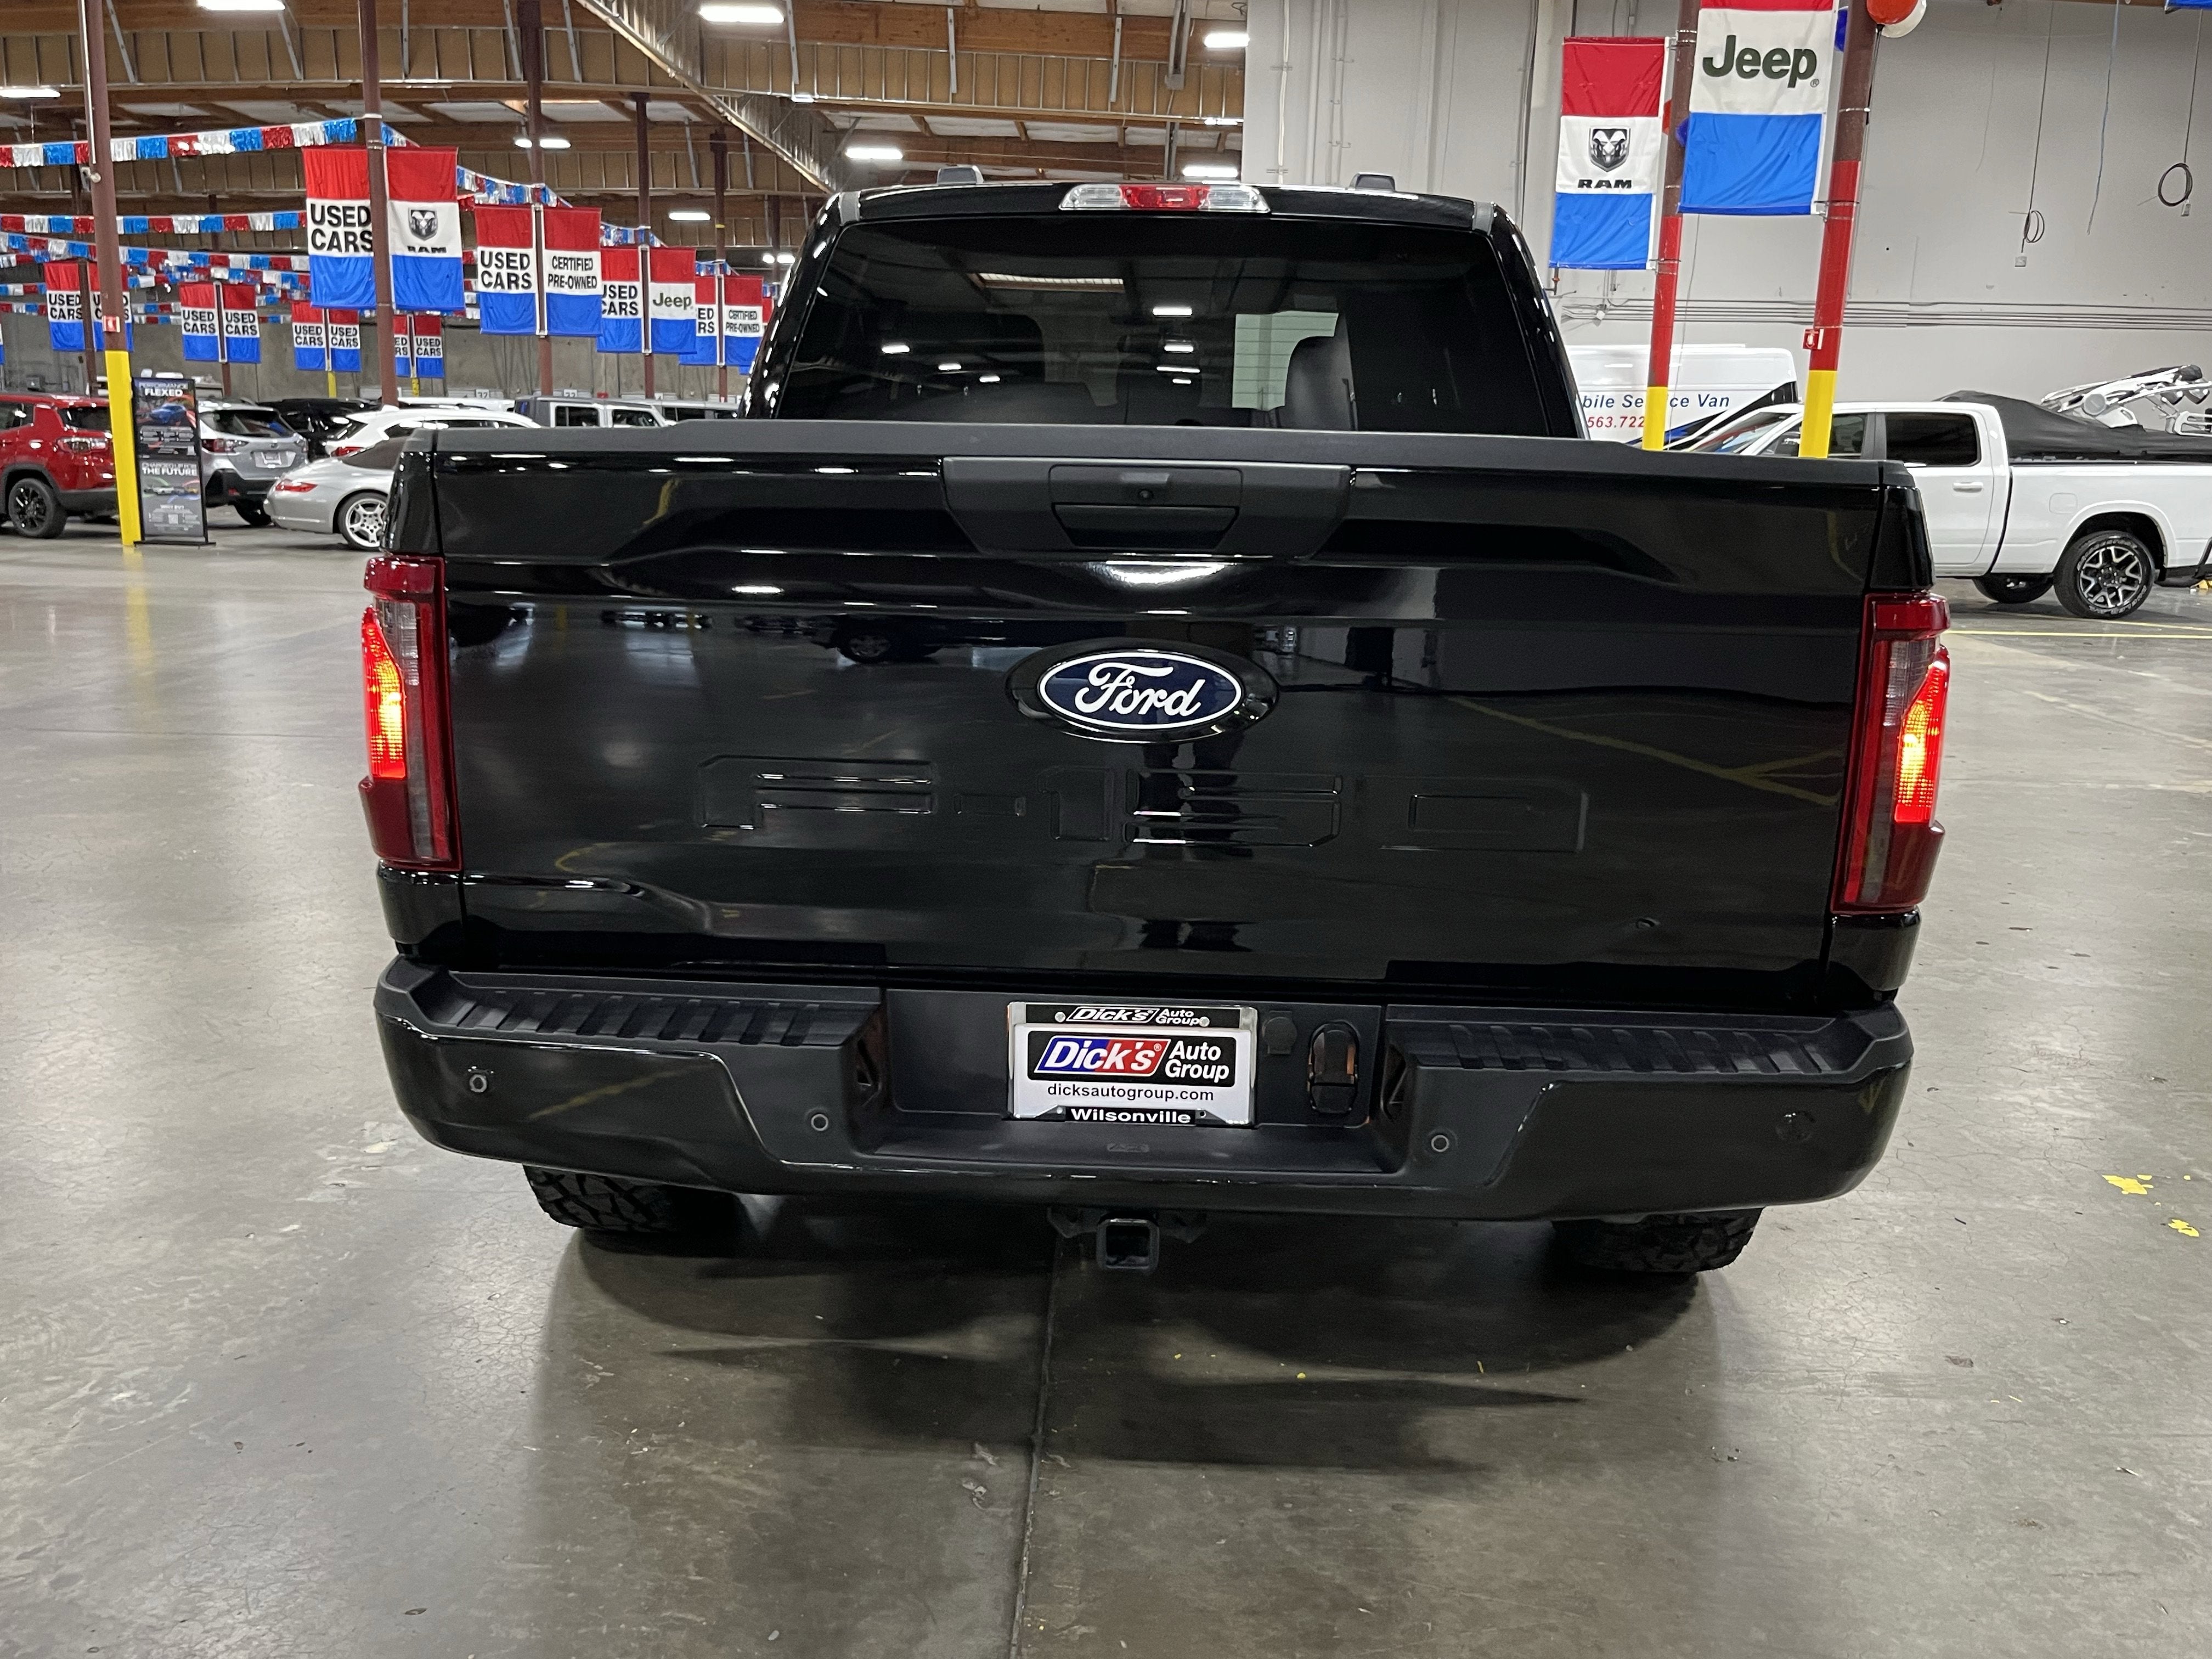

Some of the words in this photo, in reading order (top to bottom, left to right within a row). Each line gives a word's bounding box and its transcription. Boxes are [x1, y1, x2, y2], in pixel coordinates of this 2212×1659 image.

[1577, 179, 1632, 189] RAM
[311, 204, 371, 228] USED
[311, 228, 373, 253] CARS
[481, 250, 531, 270] USED
[552, 256, 593, 271] CERTIFIED
[481, 270, 532, 290] CARS
[548, 274, 597, 289] PRE-OWNED
[49, 294, 81, 306] USED
[50, 308, 82, 320] CARS
[183, 310, 215, 321] USED
[225, 312, 256, 323] USED
[184, 322, 216, 334] CARS
[225, 324, 258, 335] CARS
[294, 325, 322, 335] USED
[330, 326, 358, 336] USED
[295, 336, 323, 346] CARS
[331, 337, 358, 347] CARS
[415, 337, 441, 347] USED
[416, 347, 441, 356] CARS
[1698, 394, 1730, 408] Van
[1074, 662, 1206, 717] Ford
[1160, 1008, 1194, 1018] Auto
[1155, 1015, 1200, 1026] Group
[1169, 1040, 1221, 1062] Auto
[1164, 1059, 1229, 1084] Group
[1047, 1083, 1214, 1102] dicksautogroup.com
[1070, 1108, 1191, 1124] Wilsonville
